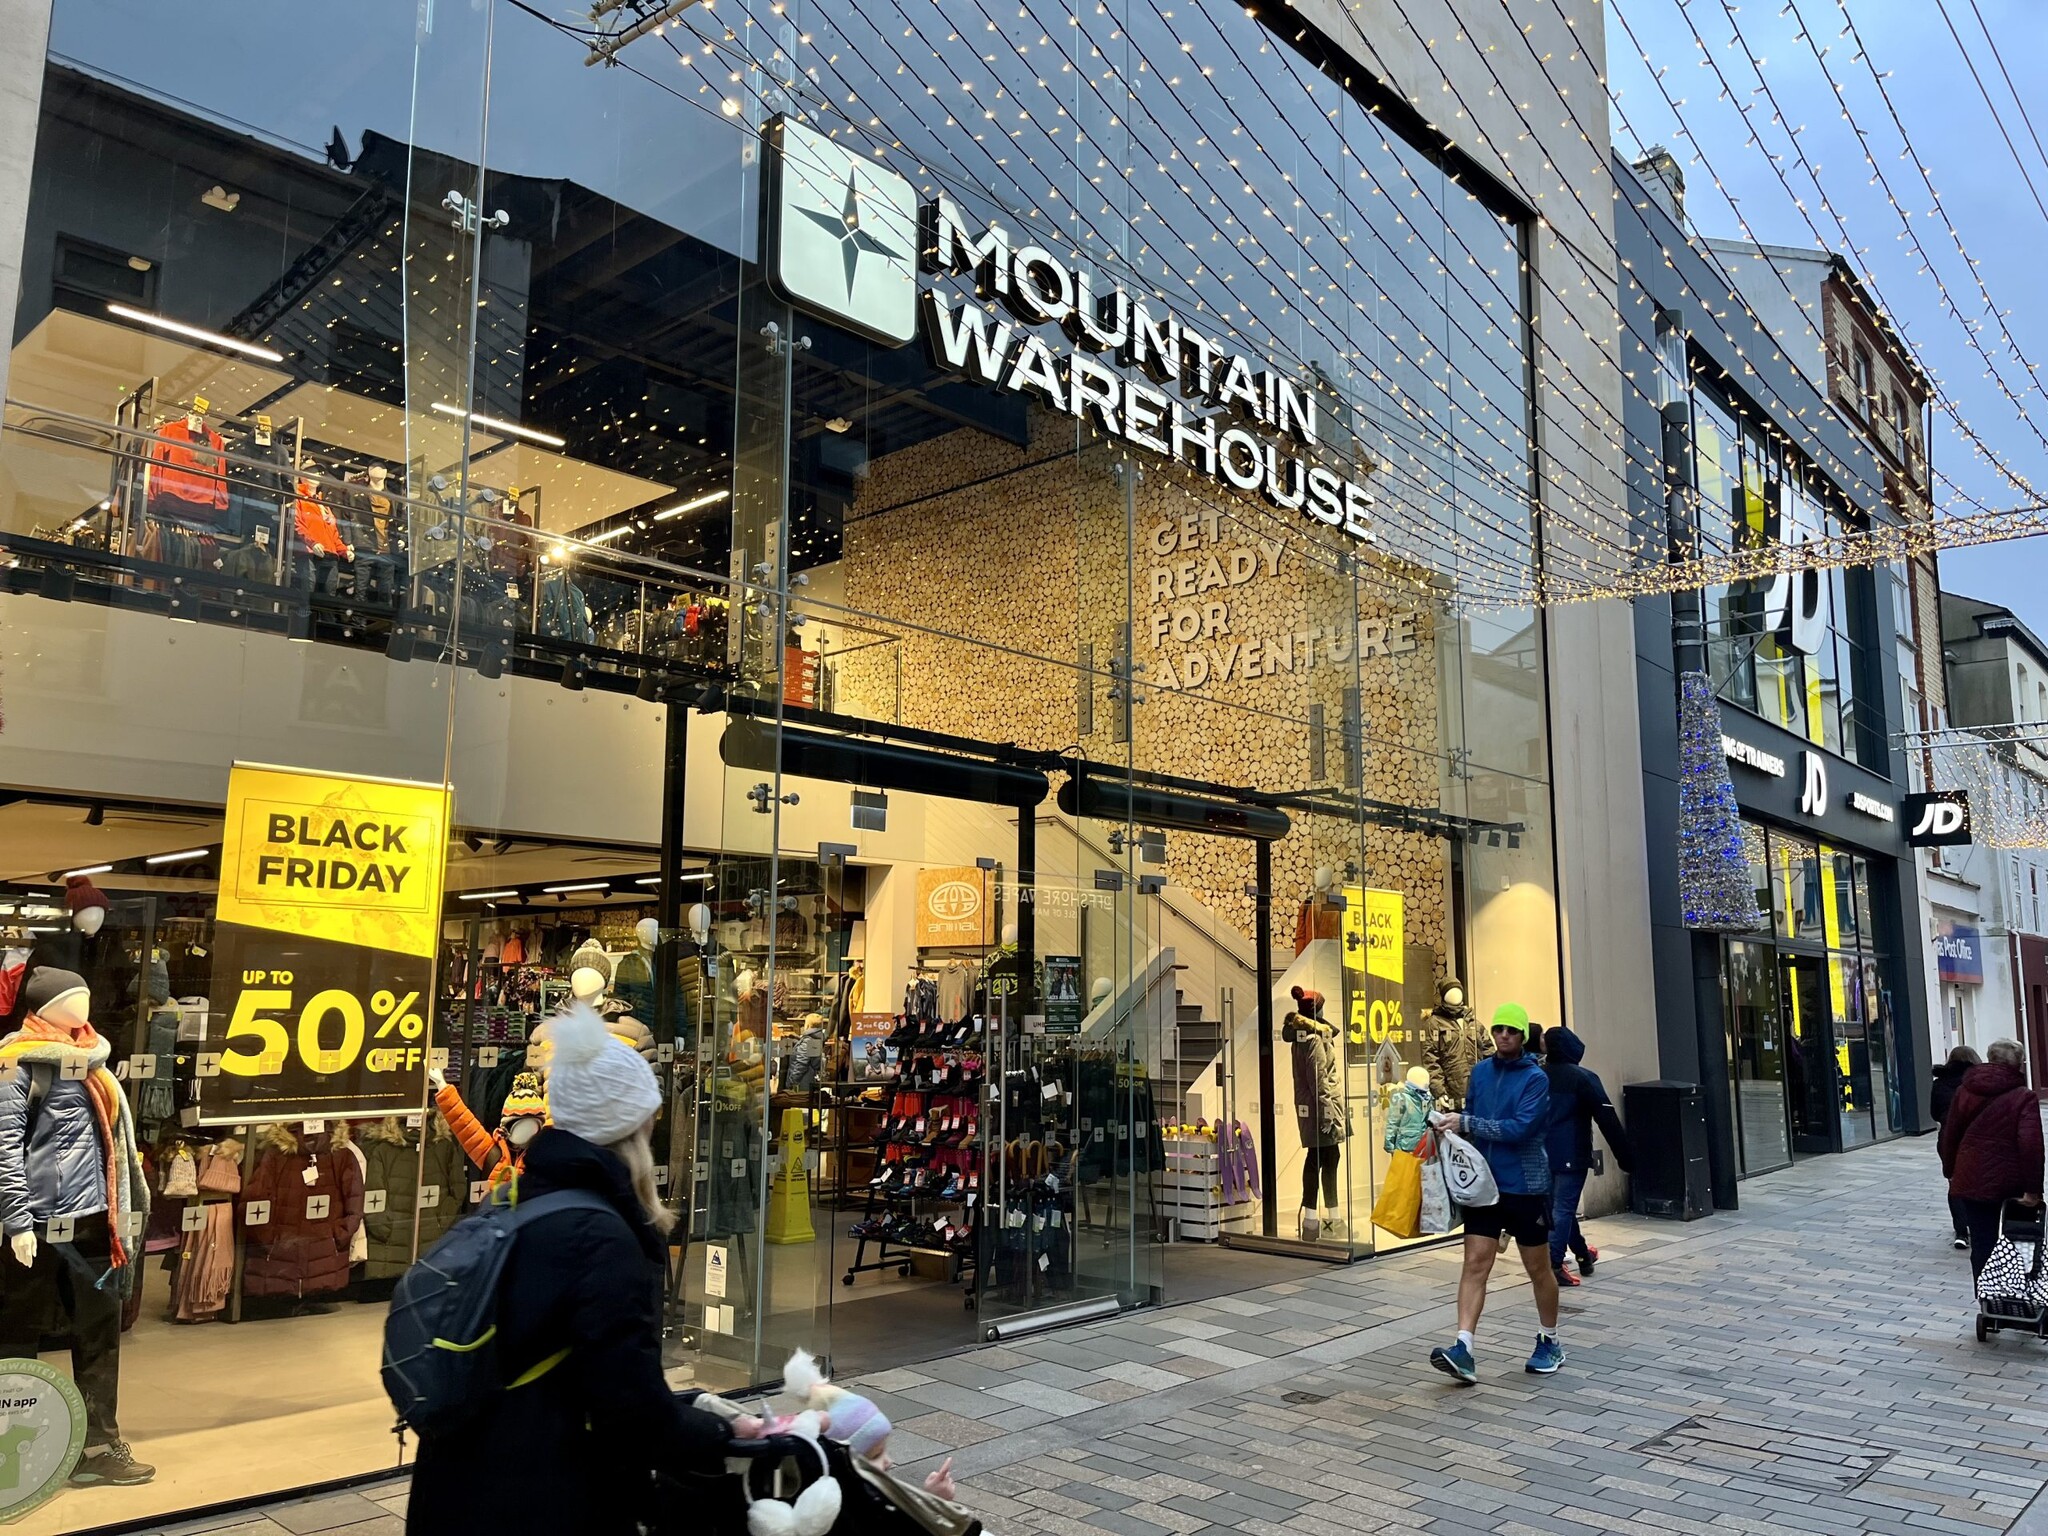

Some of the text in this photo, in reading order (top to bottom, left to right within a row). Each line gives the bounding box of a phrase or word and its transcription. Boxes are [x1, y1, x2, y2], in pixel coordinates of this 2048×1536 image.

[933, 198, 1317, 446] MOUNTAIN
[929, 287, 1377, 543] WAREHOUSE
[1151, 511, 1225, 555] GET
[1150, 537, 1289, 601] READY
[1151, 600, 1231, 649] FOR
[1154, 611, 1418, 693] ADVENTURE
[1721, 734, 1737, 758] NG
[1745, 744, 1785, 778] TRAINERS
[1801, 750, 1827, 816] JD
[267, 813, 408, 854] BLACK
[1912, 803, 1964, 836] JD
[257, 855, 411, 894] FRIDAY
[1353, 911, 1392, 928] BACK
[1944, 935, 1957, 960] Post
[1956, 938, 1973, 960] Office
[242, 970, 293, 985] UP TO
[219, 989, 424, 1077] 50%
[856, 1021, 863, 1031] 2
[1350, 999, 1403, 1044] 50%
[0, 1361, 83, 1420] NWANTED CLOTHES
[13, 1397, 37, 1408] app
